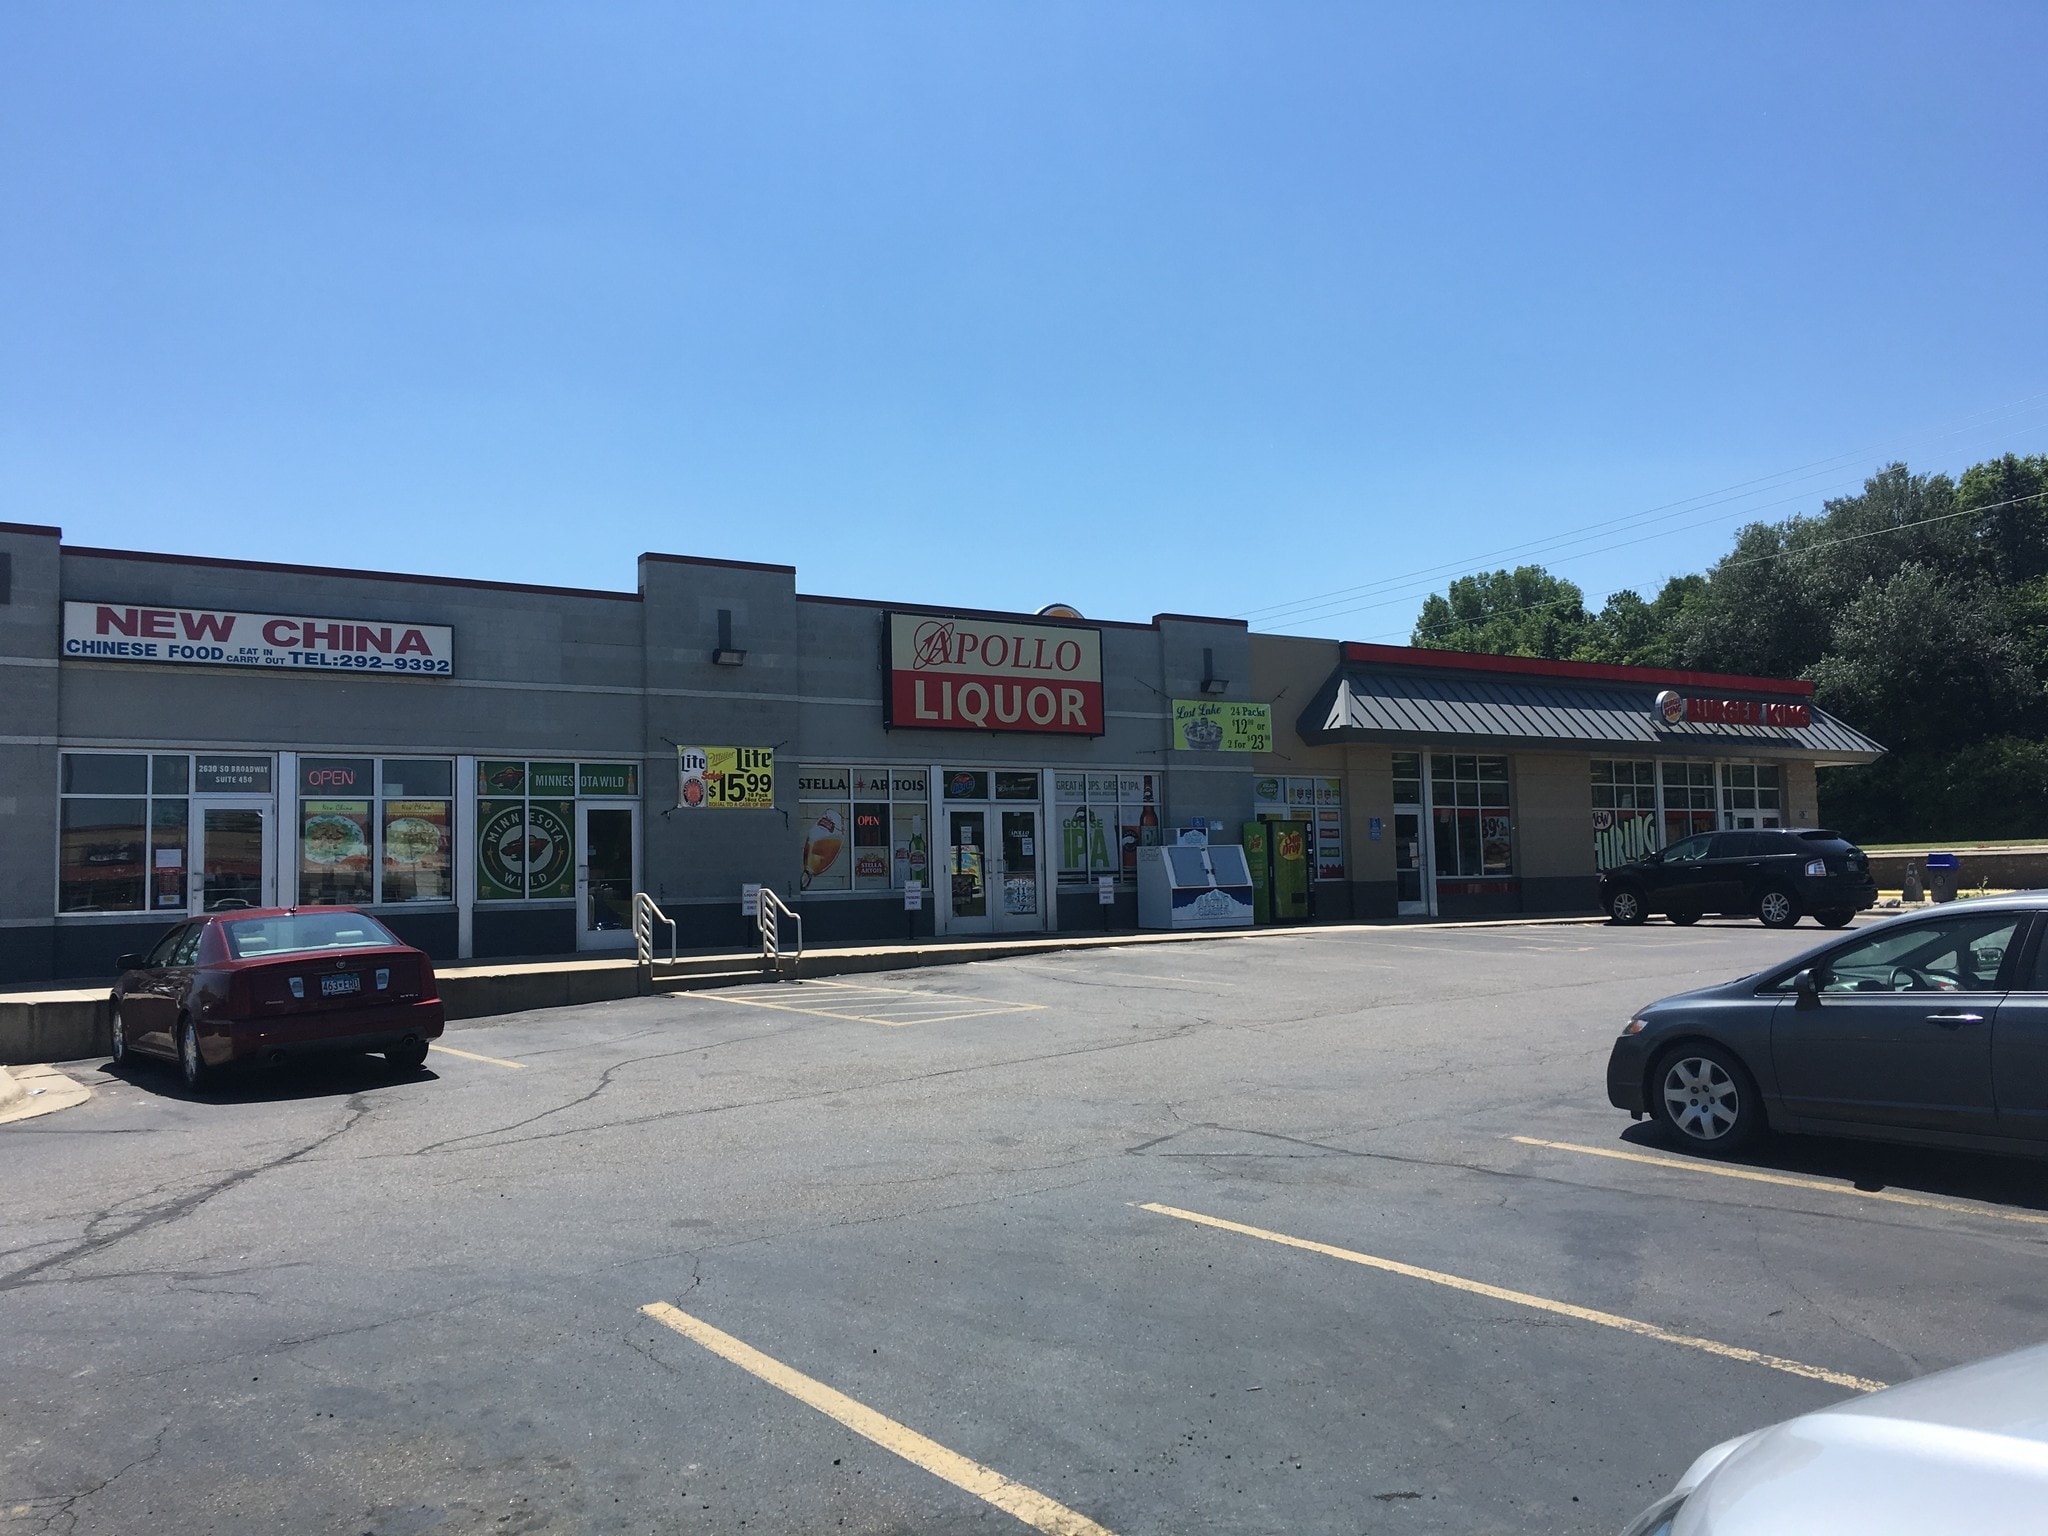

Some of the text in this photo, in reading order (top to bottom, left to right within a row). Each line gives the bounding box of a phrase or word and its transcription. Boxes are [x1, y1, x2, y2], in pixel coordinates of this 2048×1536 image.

[96, 606, 433, 656] NEW CHINA
[66, 639, 224, 661] CHINESE FOOD
[239, 647, 273, 657] EAT IN
[920, 627, 1082, 672] APOLLO
[226, 654, 285, 665] CARRY OUT
[915, 679, 1088, 728] LIQUOR
[1176, 703, 1221, 719] Lost Lake
[1230, 707, 1265, 717] 24 Packs
[1234, 740, 1246, 749] for
[681, 754, 705, 772] Lite
[708, 748, 772, 773] Miller Lite
[231, 765, 268, 774] BROADWAY
[309, 770, 354, 786] OPEN
[536, 774, 624, 788] MINNESOTA WILD
[798, 778, 925, 791] STELLA ARTOIS
[1056, 780, 1076, 790] GREAT
[487, 812, 565, 843] MINNESOTA
[858, 815, 880, 826] OPEN
[1063, 819, 1103, 828] GOOSE
[1063, 829, 1110, 868] IPA
[505, 872, 547, 886] WILD
